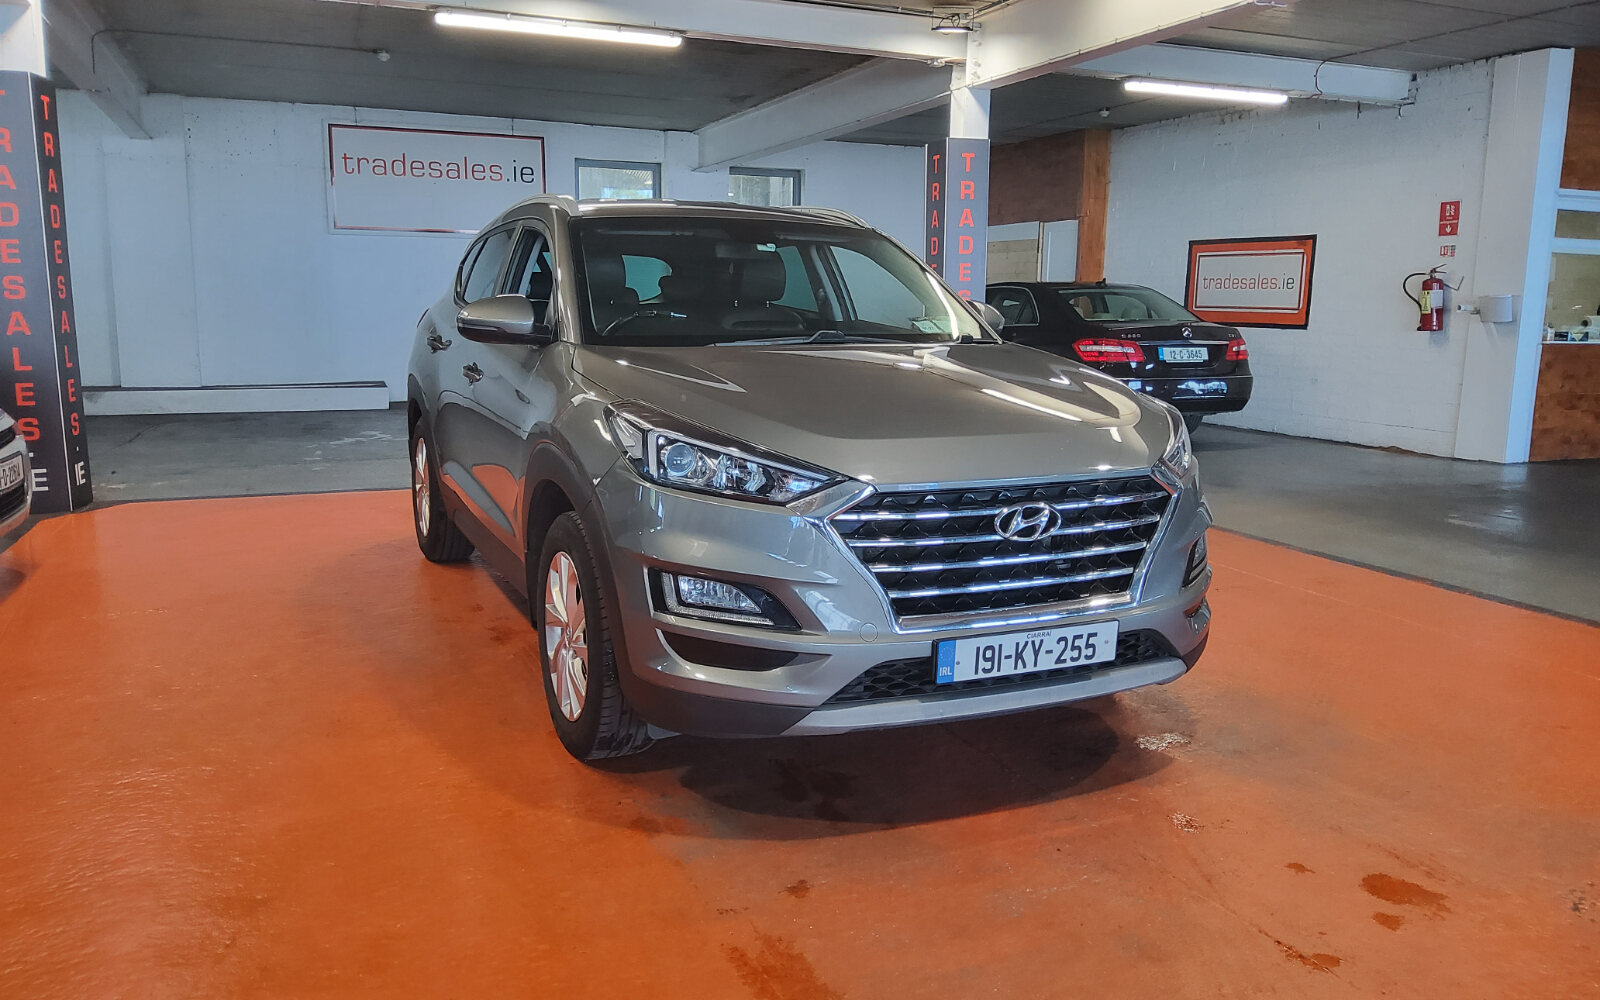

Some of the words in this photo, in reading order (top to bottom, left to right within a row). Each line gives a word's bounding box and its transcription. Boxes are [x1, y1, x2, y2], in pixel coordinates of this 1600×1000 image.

[341, 152, 535, 184] tradesales.ie
[1202, 272, 1295, 290] tradesales.ie
[974, 632, 1098, 676] 191-KY-255
[939, 666, 953, 677] IRL
